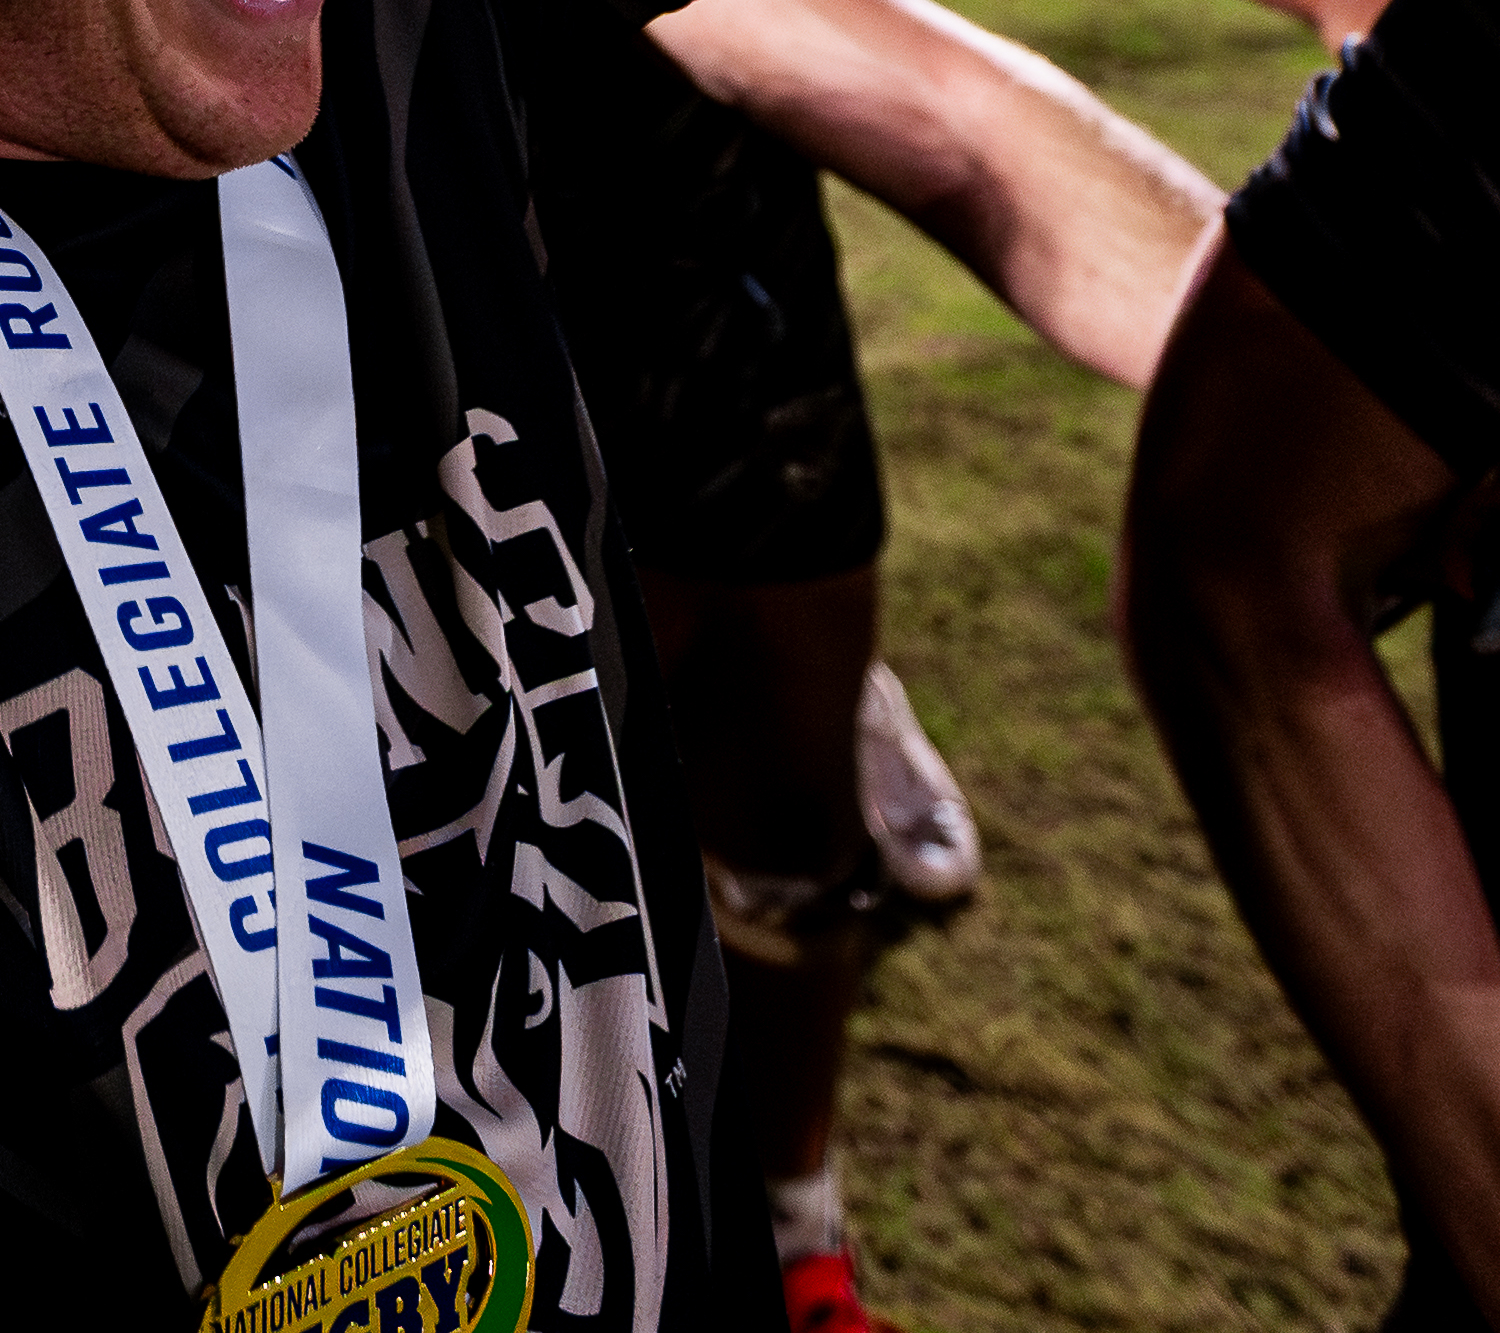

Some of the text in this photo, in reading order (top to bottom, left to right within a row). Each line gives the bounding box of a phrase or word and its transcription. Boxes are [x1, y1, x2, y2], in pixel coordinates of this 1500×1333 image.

[33, 402, 278, 954] COLLEGIATE
[302, 840, 411, 1174] NATIO
[339, 1194, 468, 1297] COLLEGIATE
